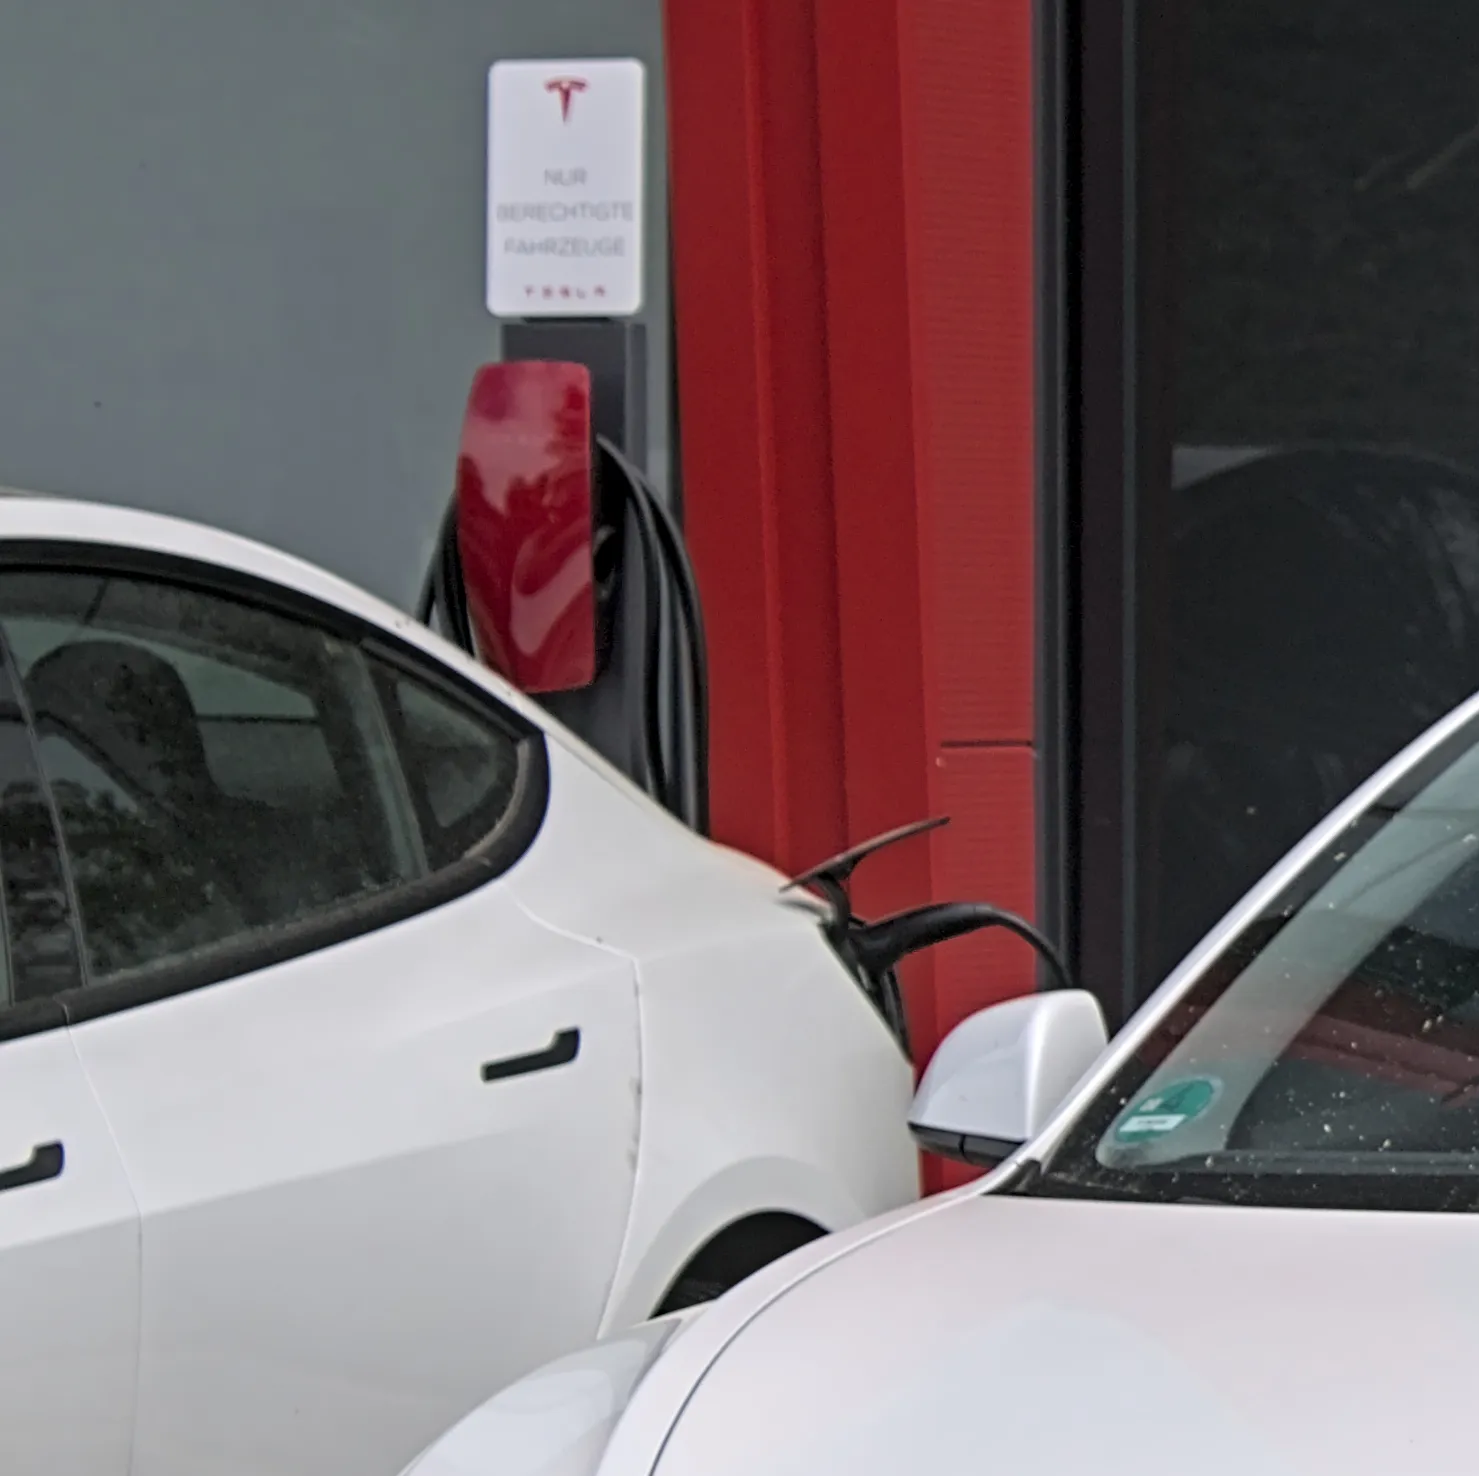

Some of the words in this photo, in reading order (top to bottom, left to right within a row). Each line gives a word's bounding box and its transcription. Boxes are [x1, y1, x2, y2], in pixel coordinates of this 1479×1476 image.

[543, 167, 588, 187] NUR
[496, 202, 633, 223] BERECHTIGTE
[503, 236, 626, 257] FAHRZEUGE
